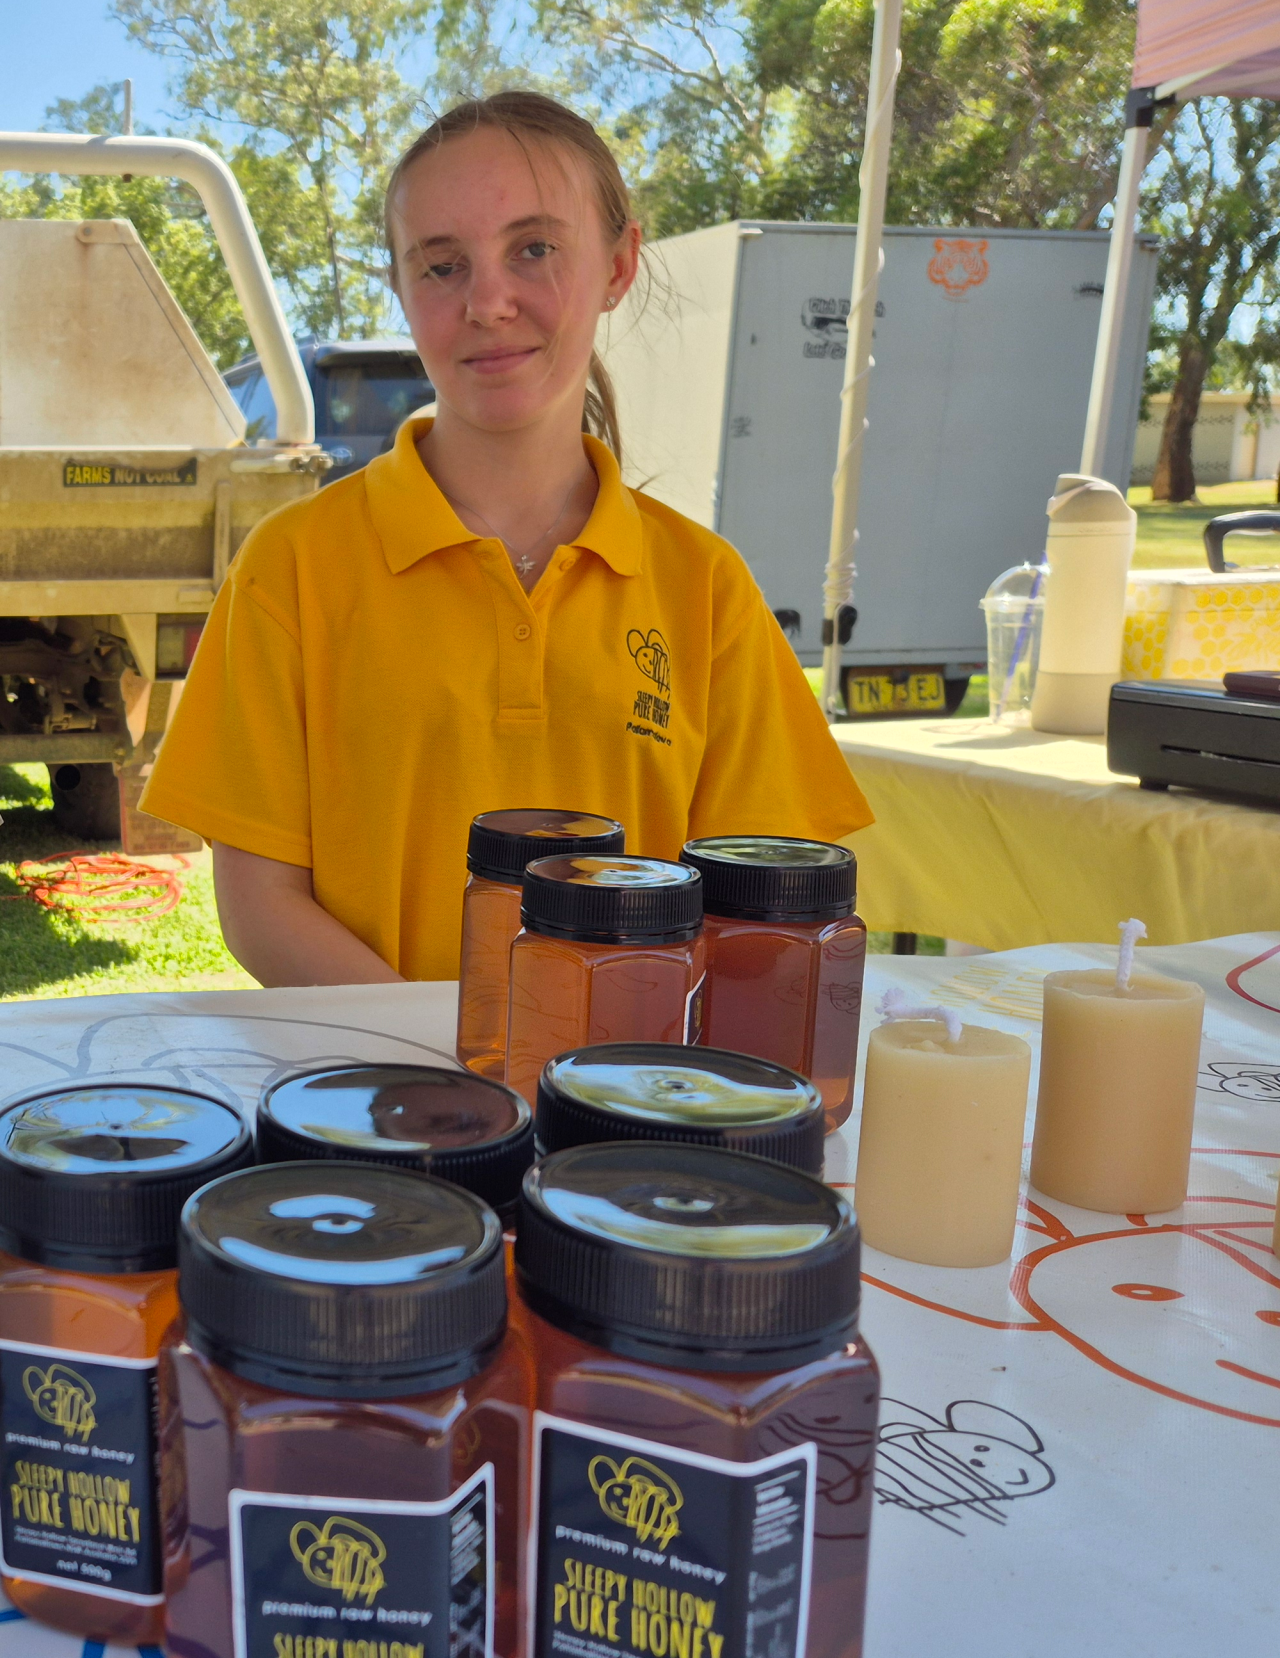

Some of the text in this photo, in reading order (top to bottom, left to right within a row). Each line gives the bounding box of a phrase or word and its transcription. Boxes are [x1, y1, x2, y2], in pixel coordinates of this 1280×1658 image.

[66, 466, 111, 484] FARMS
[633, 700, 651, 720] PURE
[5, 1432, 135, 1465] premium raw honey
[15, 1460, 130, 1505] SLEEPY HOLLOW
[10, 1484, 140, 1543] PURE HONEY
[555, 1524, 727, 1585] premium raw honey
[564, 1557, 628, 1602] SLEEPY
[633, 1578, 716, 1629] HOLLOW
[262, 1600, 432, 1627] premium raw honey
[554, 1583, 622, 1642] PURE
[631, 1604, 725, 1658] HONEY
[273, 1632, 338, 1658] SLEEPY
